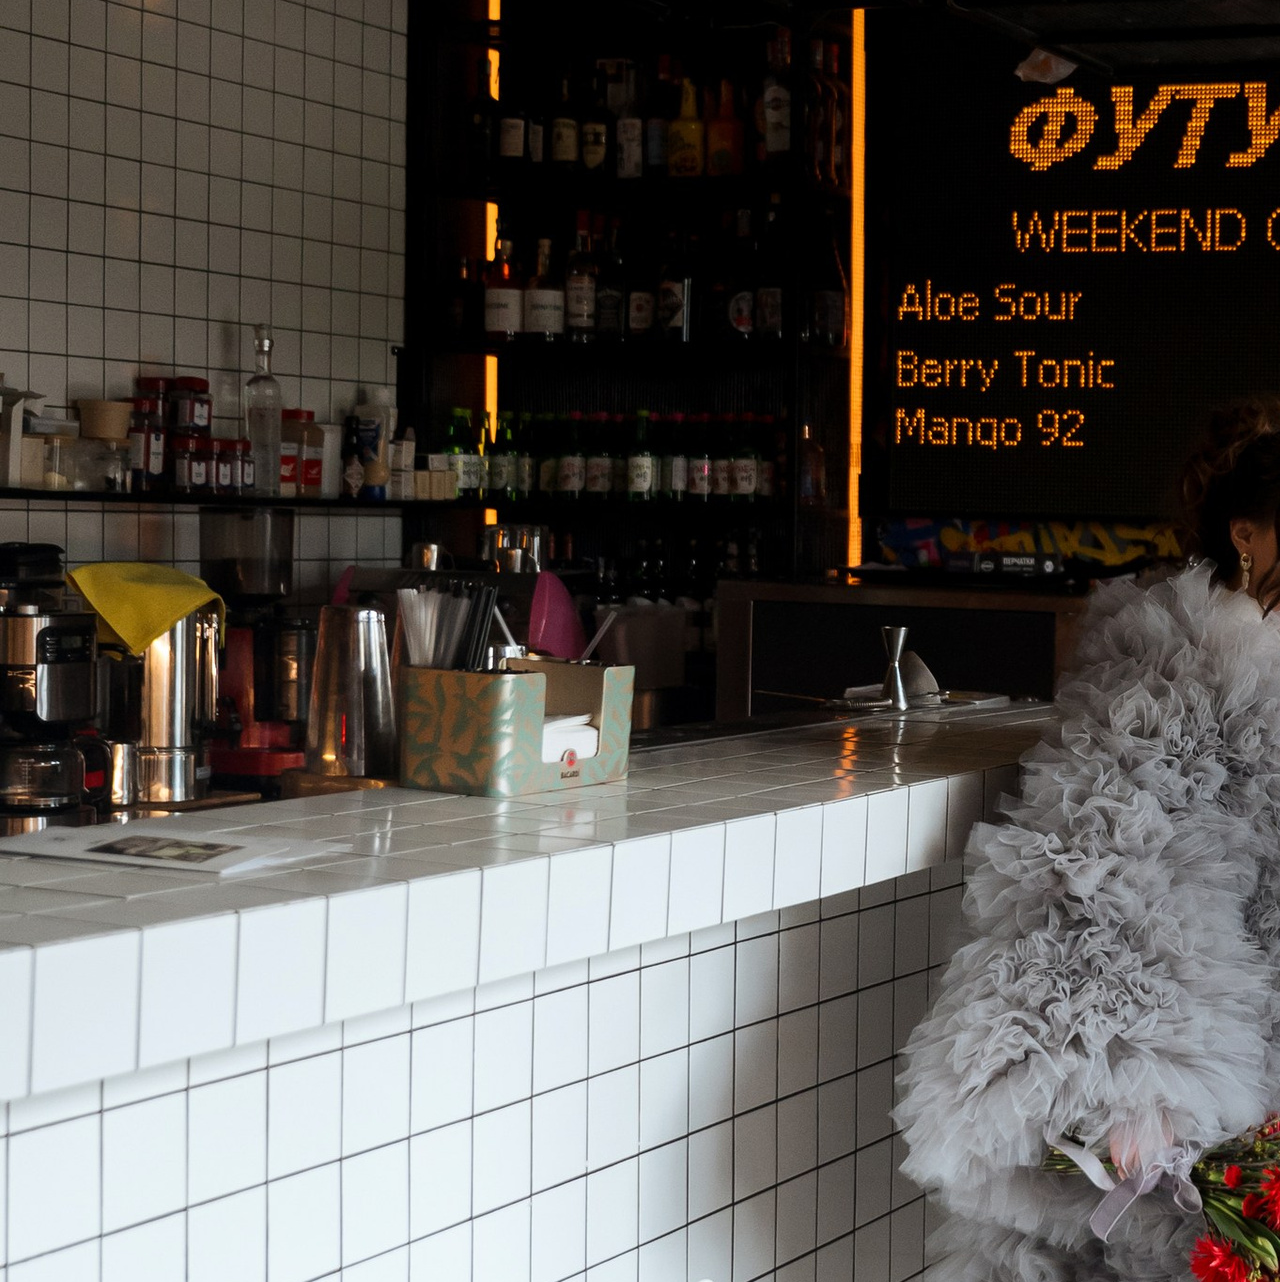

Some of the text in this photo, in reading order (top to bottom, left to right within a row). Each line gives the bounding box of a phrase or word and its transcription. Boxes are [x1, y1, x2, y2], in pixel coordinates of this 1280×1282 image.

[1011, 207, 1248, 254] WEEKEND
[896, 278, 1084, 322] Aloe Sour
[895, 349, 1116, 393] Berry Tonic
[1036, 408, 1086, 448] 92
